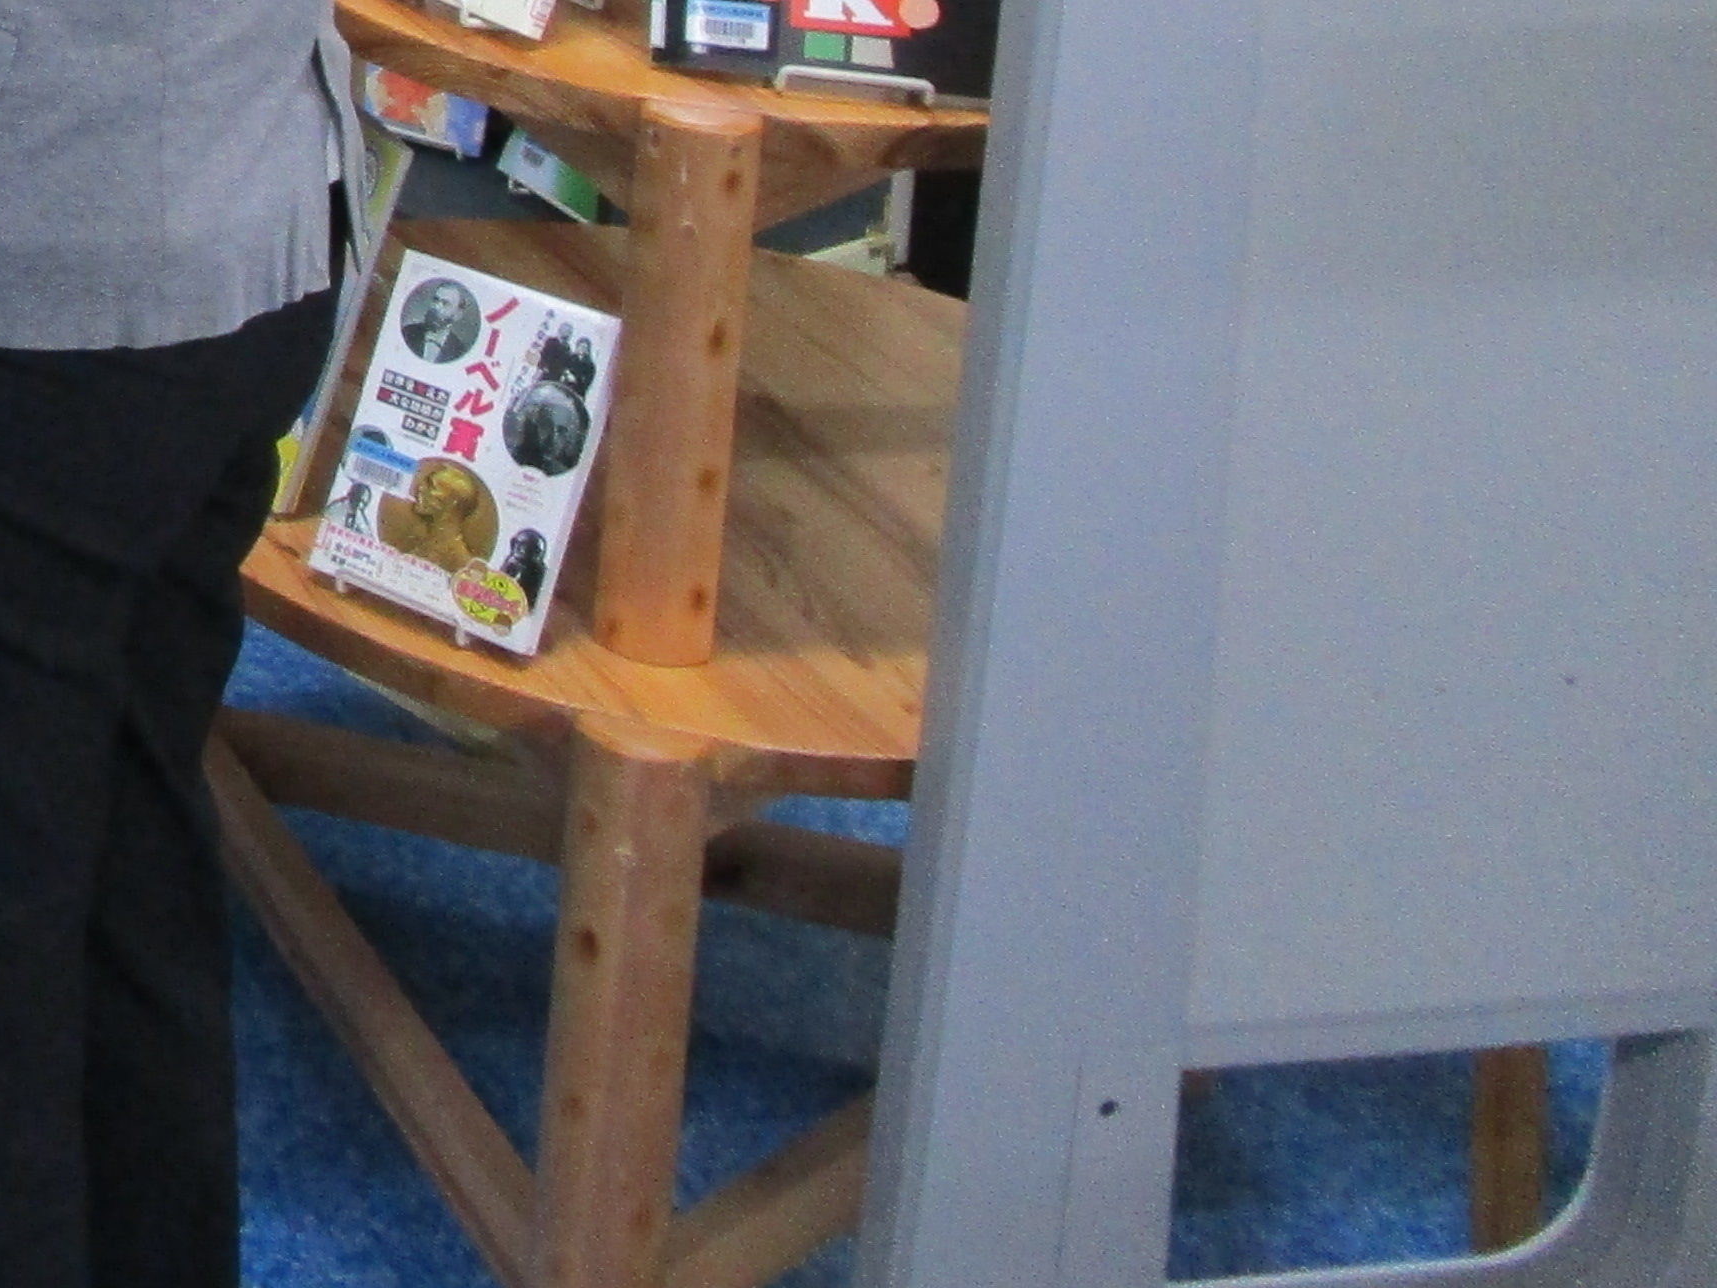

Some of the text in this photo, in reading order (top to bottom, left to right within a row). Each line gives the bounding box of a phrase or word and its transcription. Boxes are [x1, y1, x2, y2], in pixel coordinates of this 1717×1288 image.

[440, 295, 521, 463] ノーベル賞
